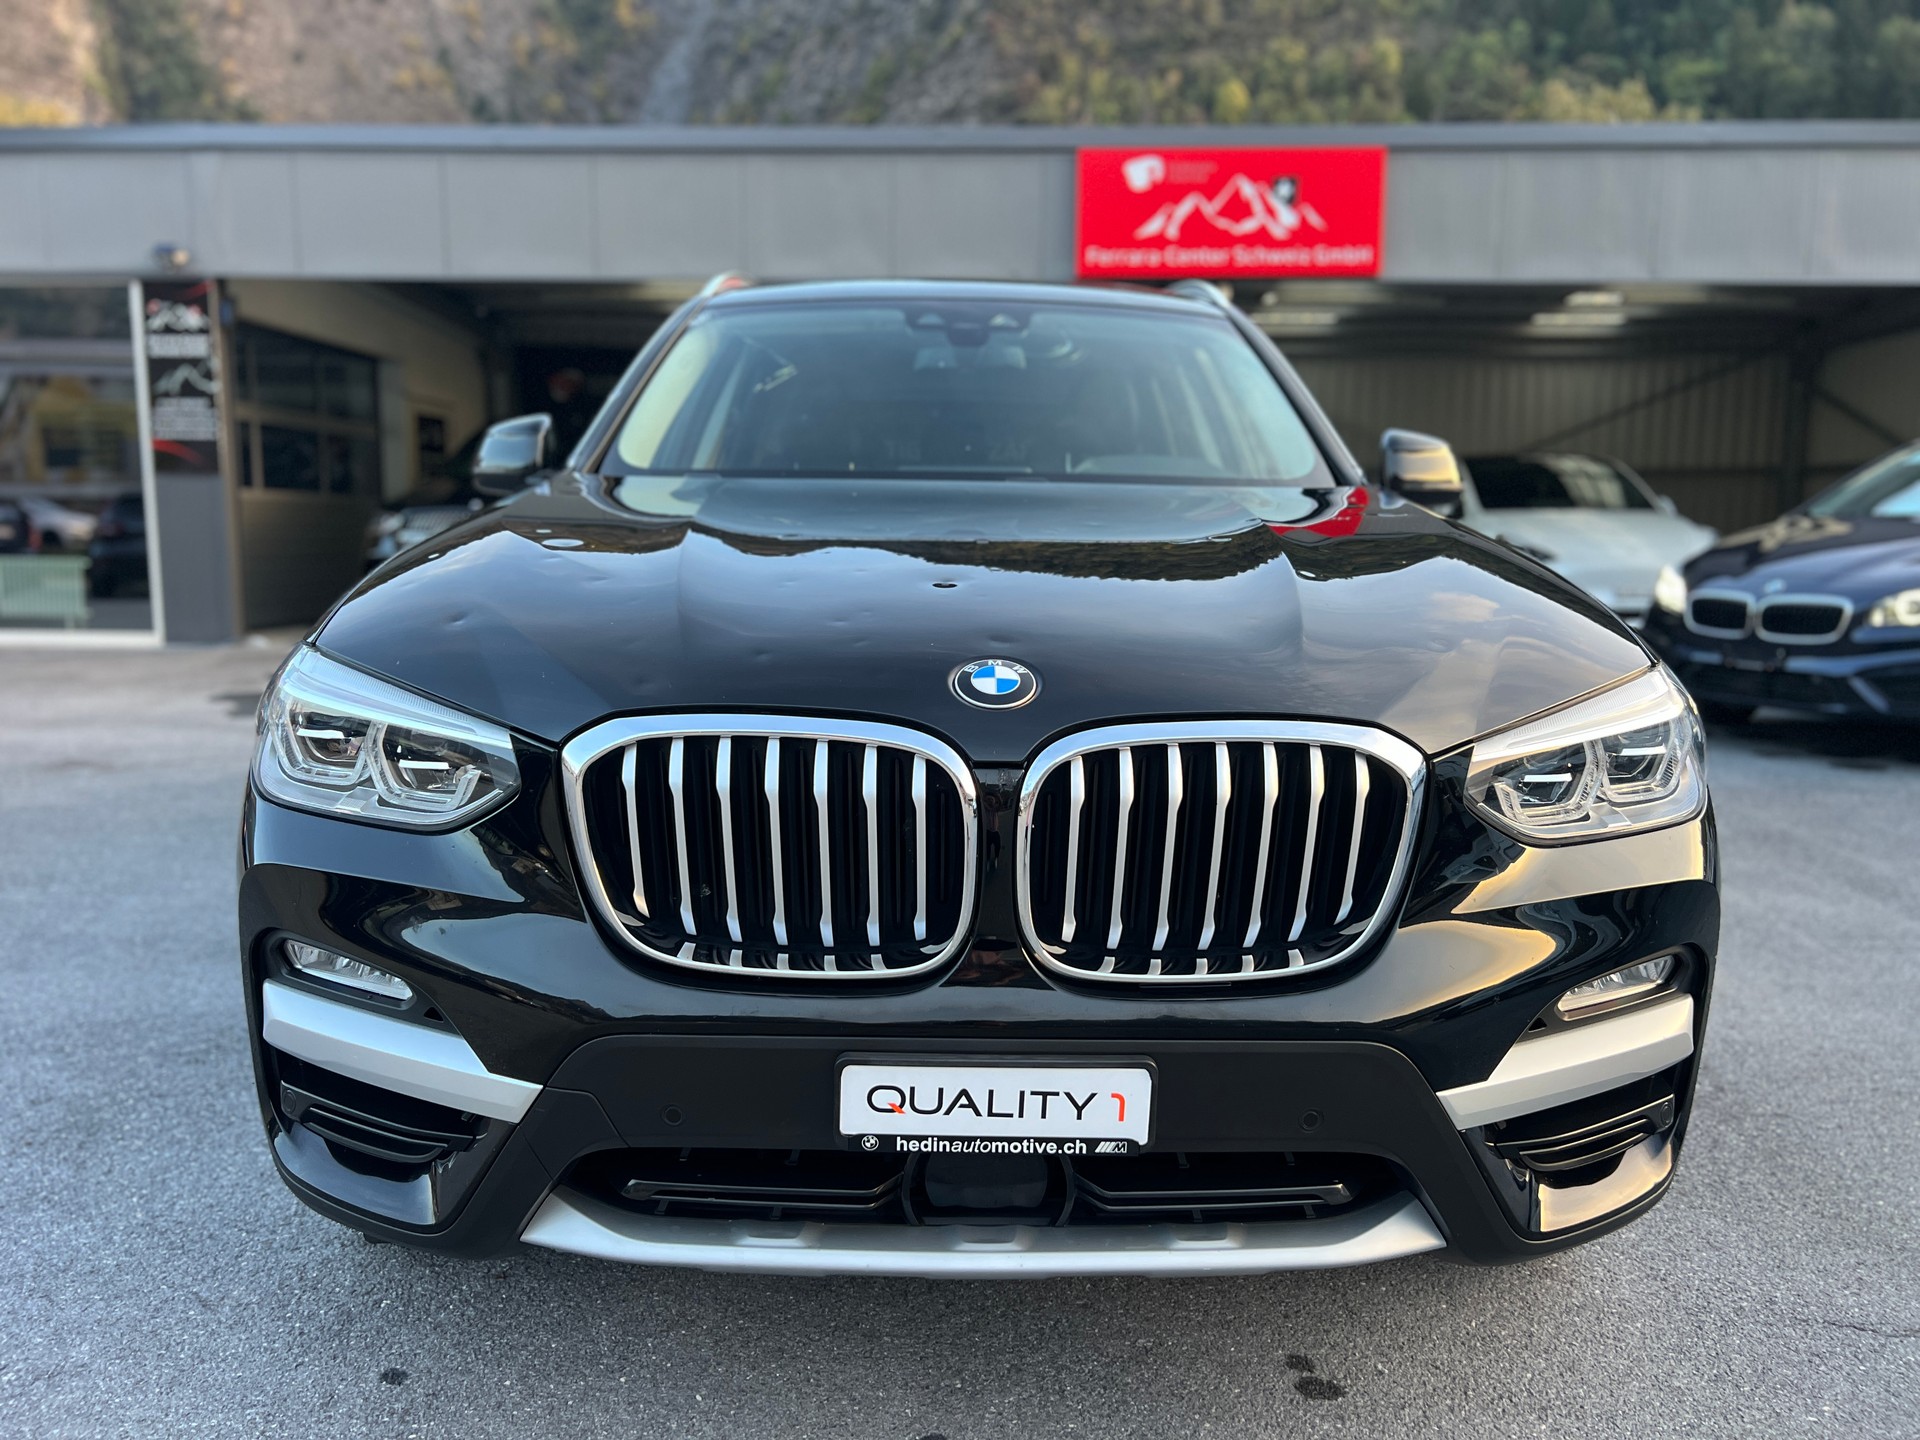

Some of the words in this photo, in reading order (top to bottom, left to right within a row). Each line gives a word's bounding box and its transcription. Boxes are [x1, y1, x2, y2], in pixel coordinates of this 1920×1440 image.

[1233, 244, 1311, 267] Schweiz
[1313, 244, 1373, 266] GmbH
[964, 660, 1028, 674] BMW
[866, 1085, 1098, 1120] QUALITY
[1110, 1093, 1126, 1122] 1
[896, 1136, 1087, 1154] hedinautomotive.ch
